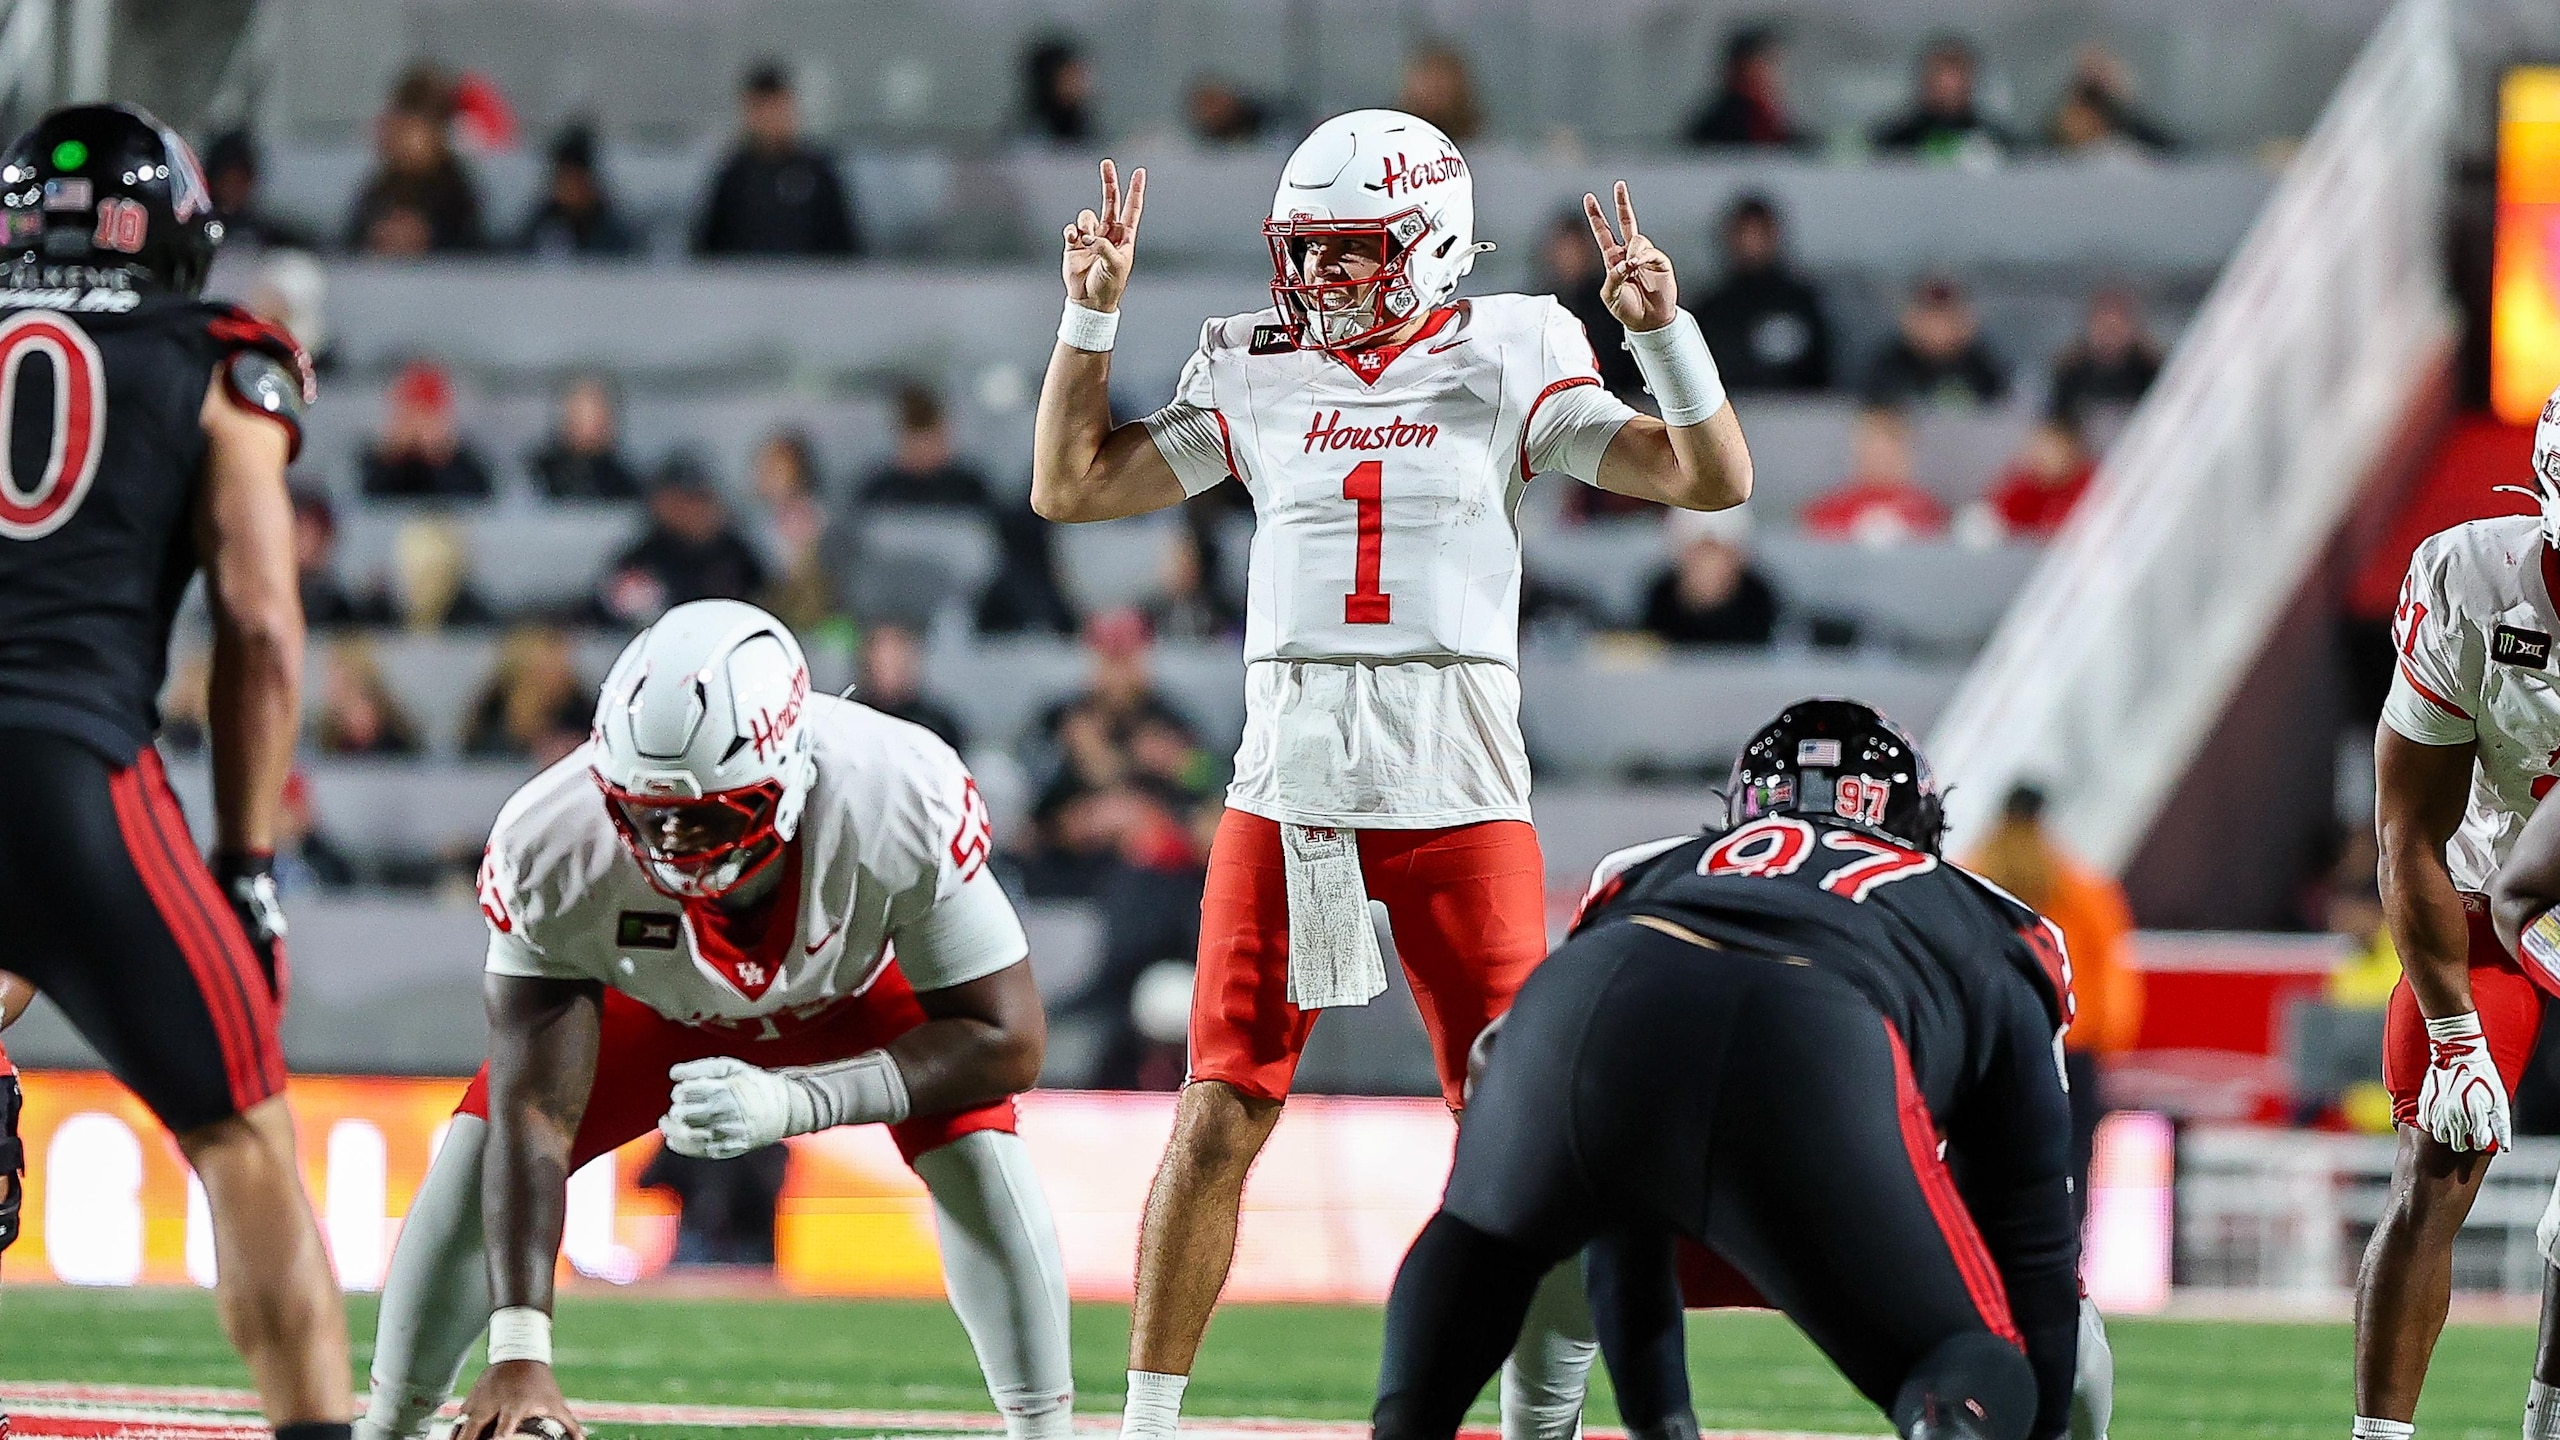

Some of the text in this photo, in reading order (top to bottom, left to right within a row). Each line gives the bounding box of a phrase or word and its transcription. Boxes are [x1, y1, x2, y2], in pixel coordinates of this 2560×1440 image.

[1382, 149, 1466, 199] Houston
[92, 197, 149, 254] 10
[1303, 409, 1438, 454] Houston
[1342, 460, 1391, 624] 1
[1834, 774, 1892, 825] 97
[1695, 815, 1939, 905] 97
